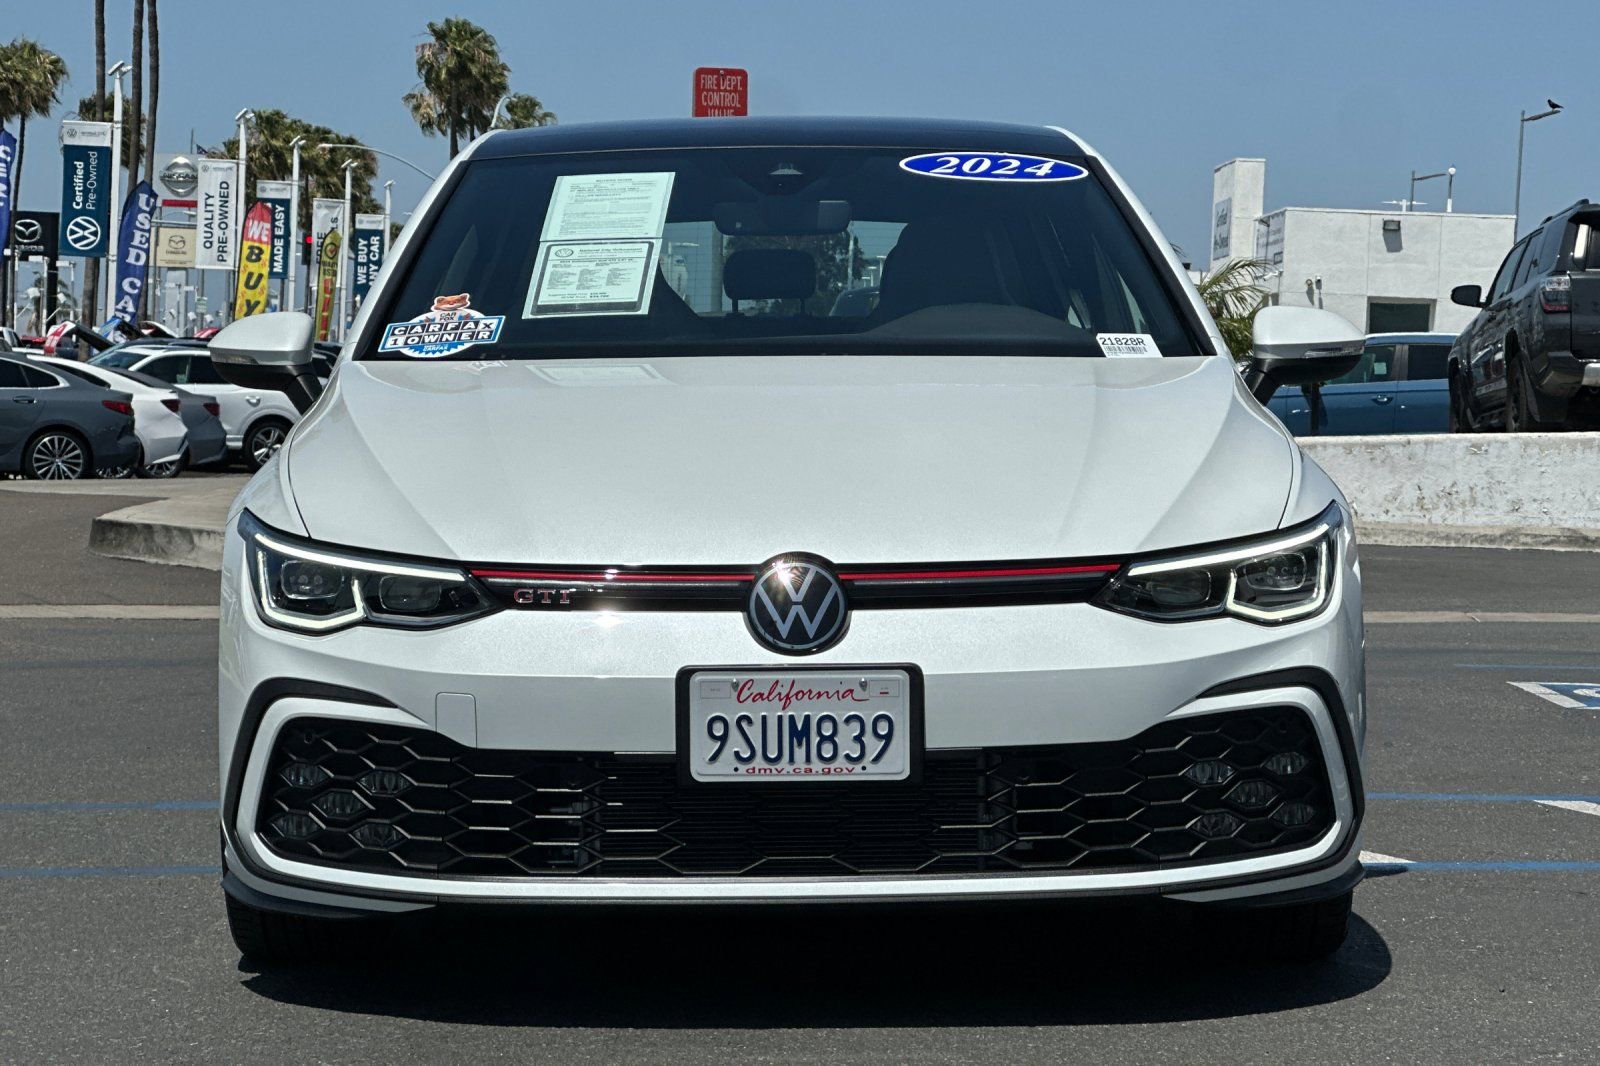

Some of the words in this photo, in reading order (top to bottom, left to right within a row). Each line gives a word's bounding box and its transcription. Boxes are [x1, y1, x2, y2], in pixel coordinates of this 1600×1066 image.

[700, 74, 718, 90] FIRE
[701, 91, 742, 107] CONTROL
[930, 156, 1055, 176] 2024
[72, 161, 84, 210] Certified
[85, 151, 98, 210] Pre-Owned
[125, 193, 155, 266] USED
[203, 192, 215, 250] QUALITY
[216, 181, 230, 262] PRE-OWNED
[247, 219, 270, 243] WE
[274, 204, 285, 237] EASY
[272, 239, 284, 273] MADE
[357, 238, 368, 263] BUY
[369, 236, 381, 261] CAR
[243, 245, 265, 318] BUY
[357, 265, 367, 285] WE
[391, 336, 401, 346] 1
[406, 331, 491, 345] OWNER
[394, 321, 495, 335] CARFAX
[1099, 337, 1146, 346] 21828R
[513, 588, 570, 604] GTI
[736, 679, 870, 710] California
[706, 712, 895, 765] 9SUM839
[745, 766, 856, 776] dmv.ca.gov
